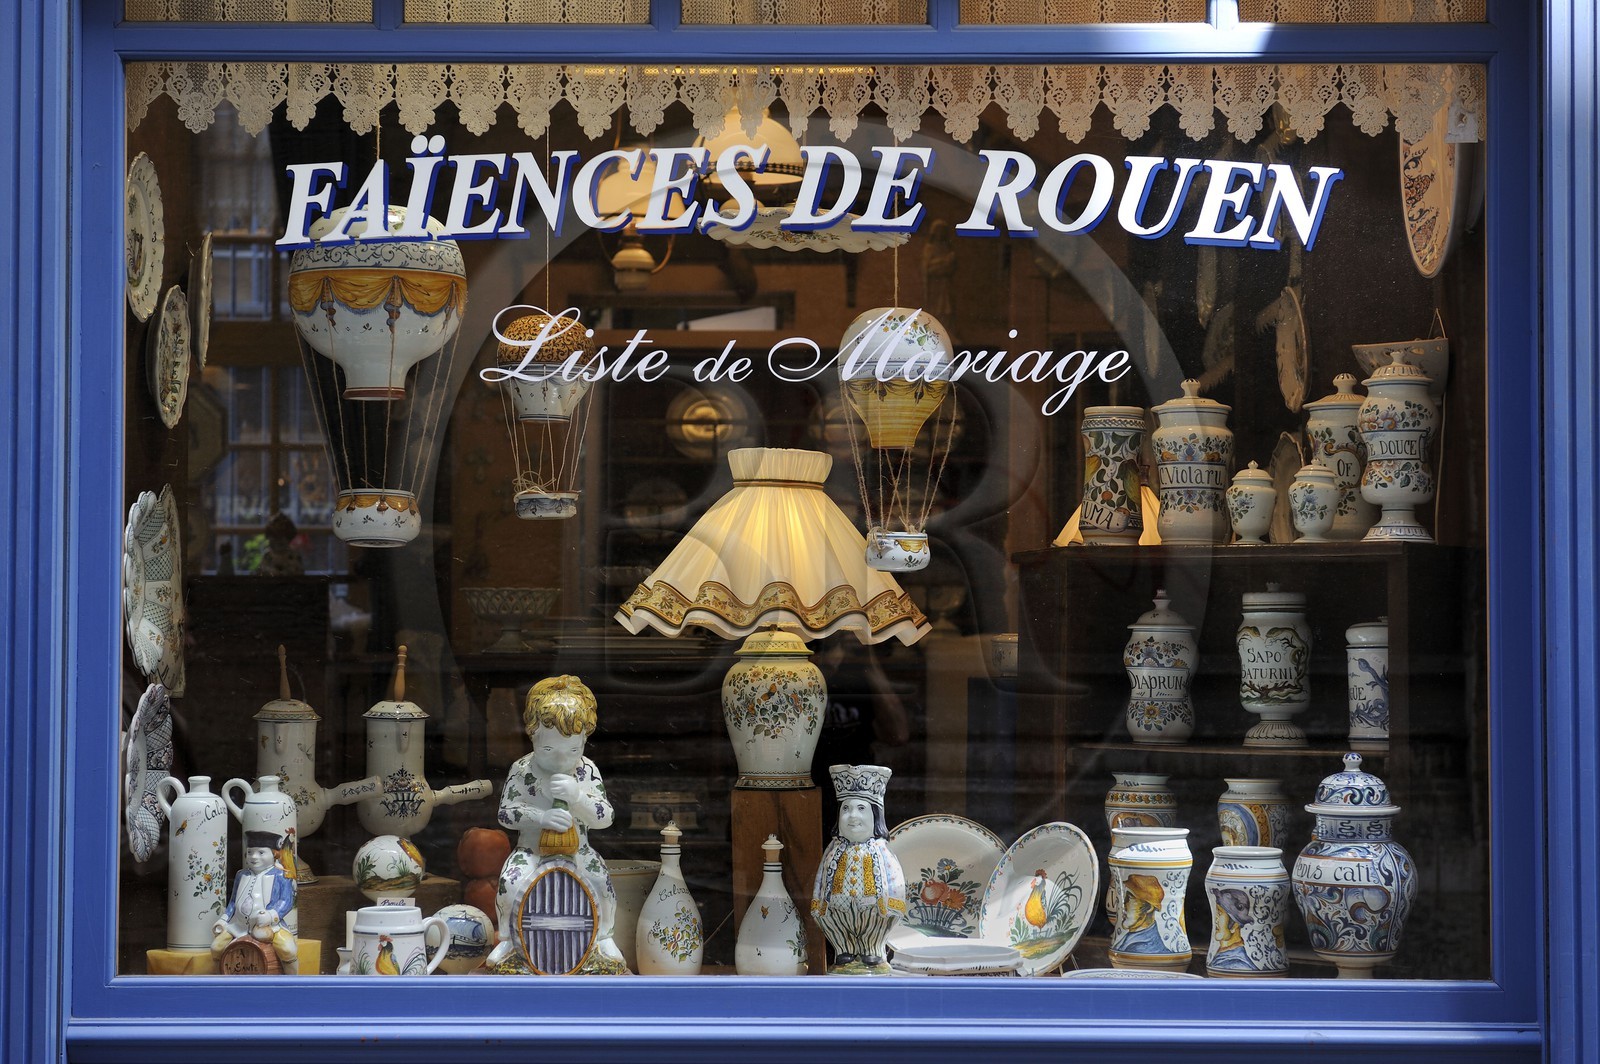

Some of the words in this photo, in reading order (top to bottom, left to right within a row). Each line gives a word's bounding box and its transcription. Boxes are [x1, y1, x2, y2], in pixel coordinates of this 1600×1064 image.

[274, 134, 771, 251] FAÏENCES
[779, 145, 935, 233] DE
[955, 149, 1344, 252] ROUEN
[480, 304, 669, 383] Liste
[692, 339, 753, 383] de
[767, 307, 1131, 416] Mariage
[1380, 440, 1418, 457] DOUCE
[1083, 501, 1119, 530] UMA.
[1247, 647, 1282, 664] SAPO
